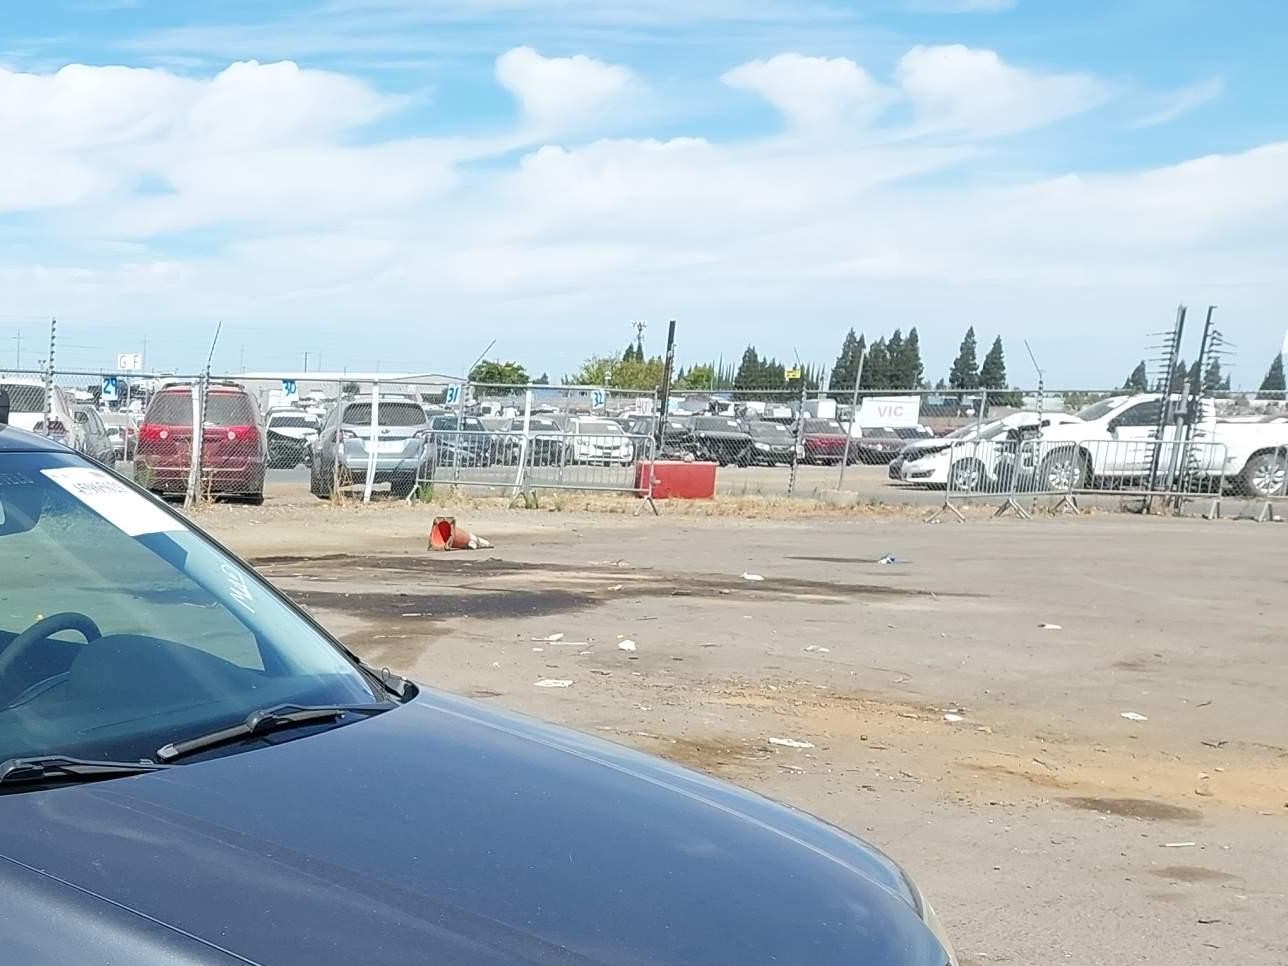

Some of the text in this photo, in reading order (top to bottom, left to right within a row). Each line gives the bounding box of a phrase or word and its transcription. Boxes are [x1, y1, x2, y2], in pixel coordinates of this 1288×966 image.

[103, 373, 118, 392] 29
[447, 387, 459, 403] 31
[877, 404, 905, 418] VIC
